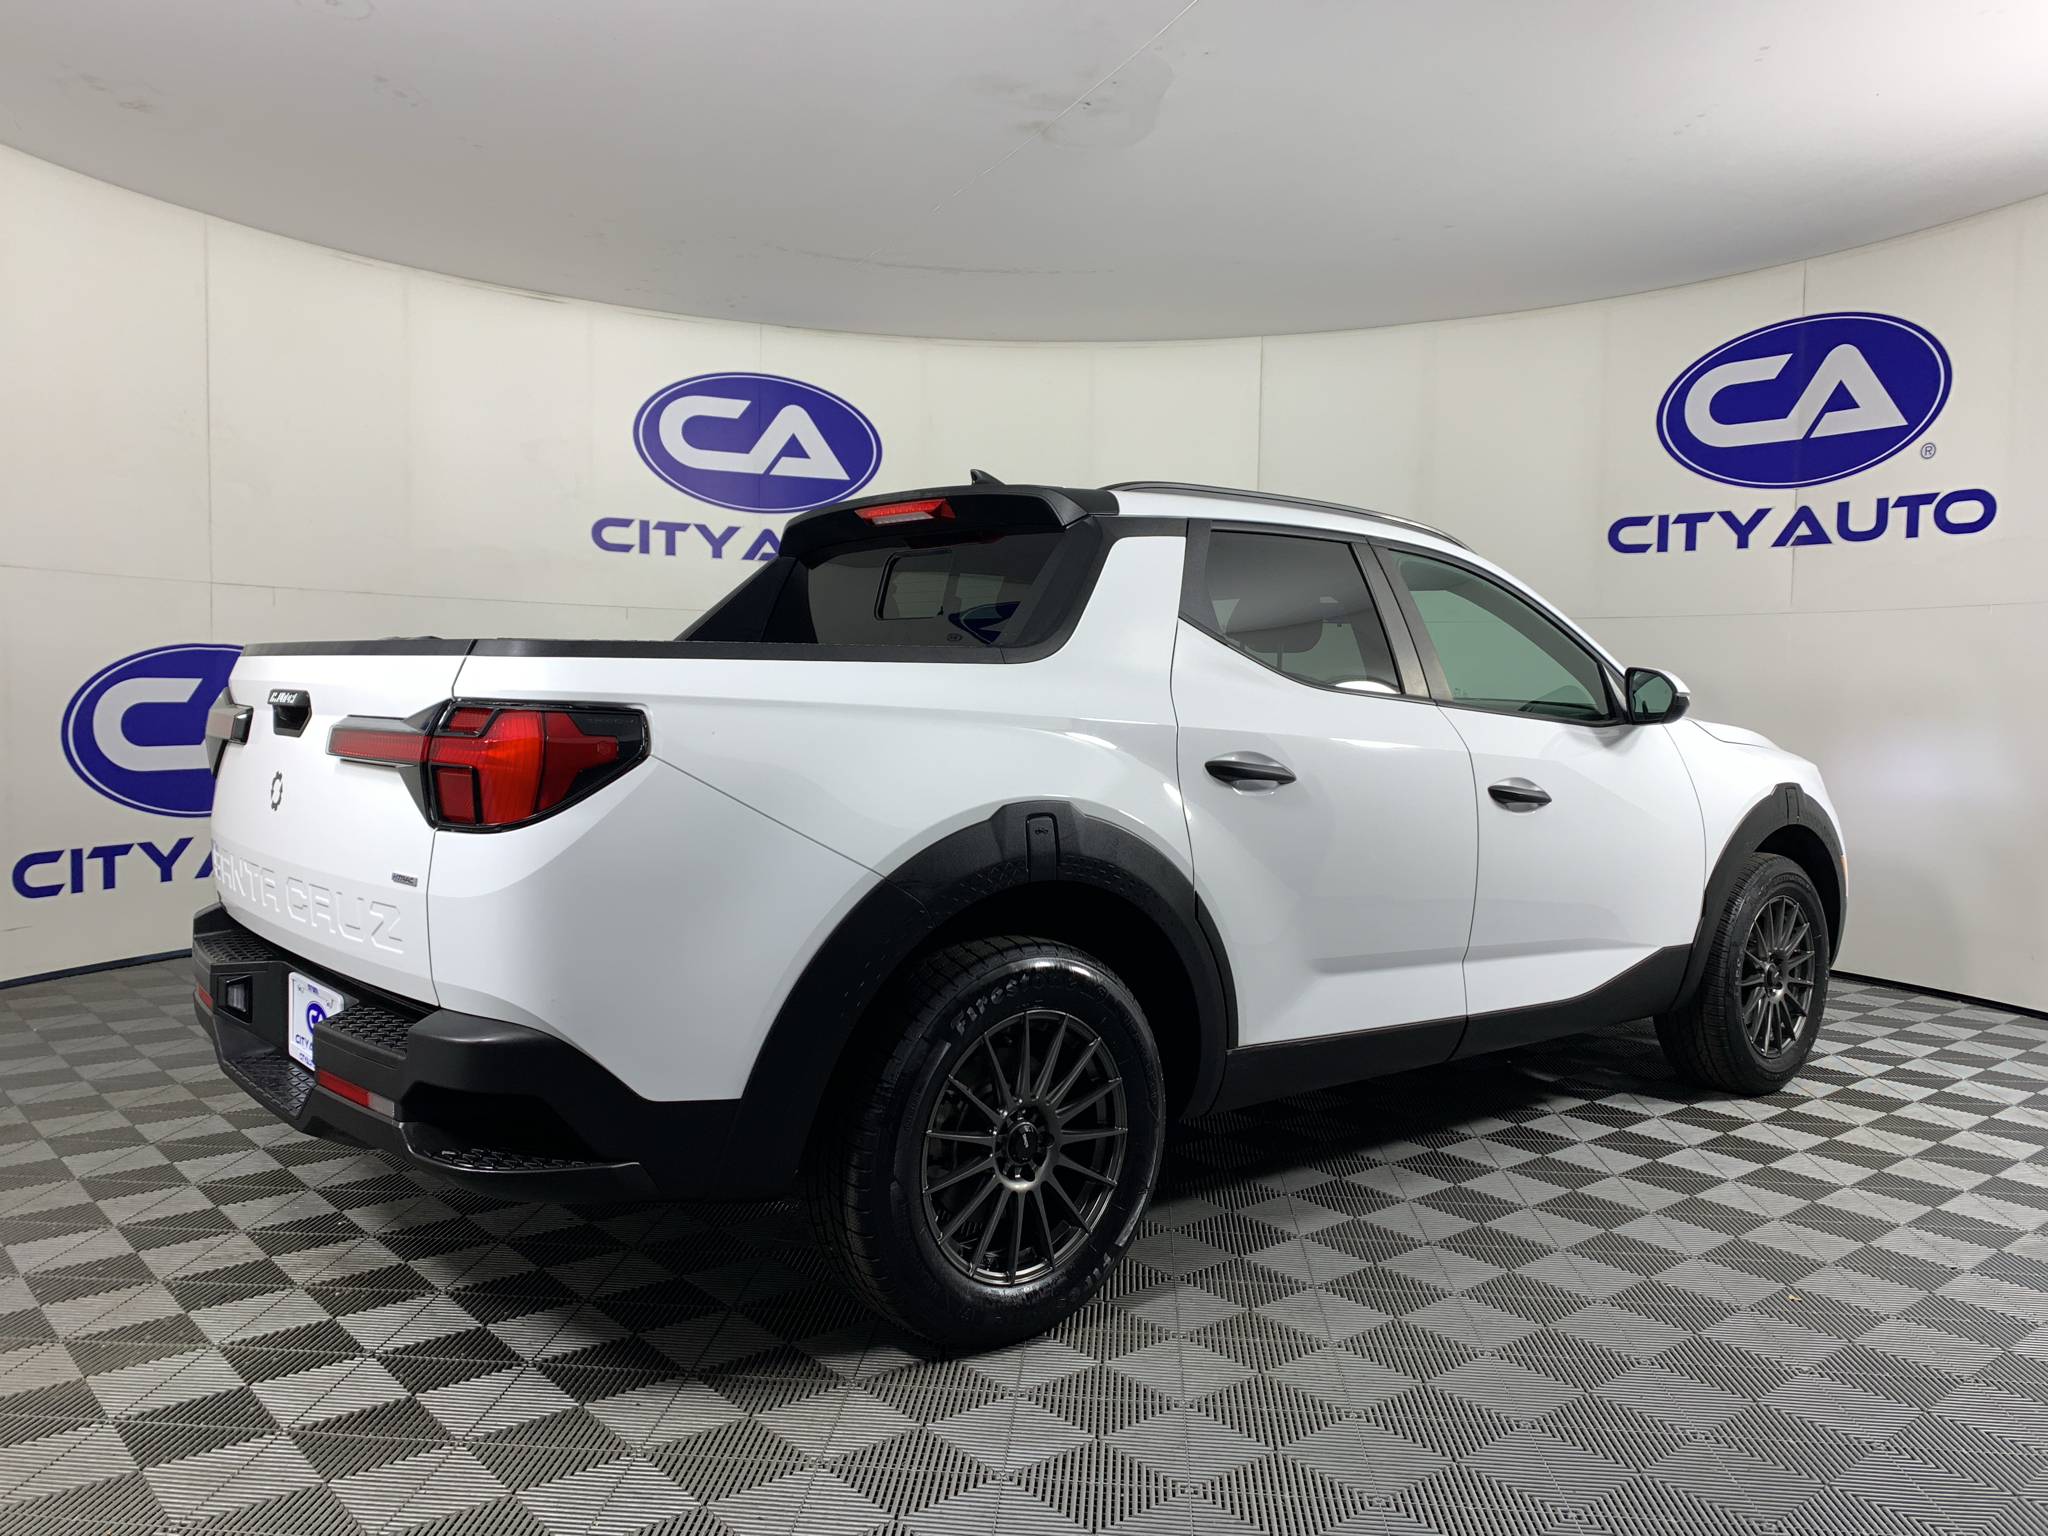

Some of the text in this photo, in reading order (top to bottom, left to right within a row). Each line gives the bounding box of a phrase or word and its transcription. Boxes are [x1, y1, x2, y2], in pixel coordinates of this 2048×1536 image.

[1684, 343, 1908, 448] CA
[658, 395, 851, 481] CA
[591, 517, 741, 559] CITY
[1607, 488, 1997, 554] CITY AUTO
[12, 837, 194, 899] CITY
[285, 876, 405, 955] CRUZ
